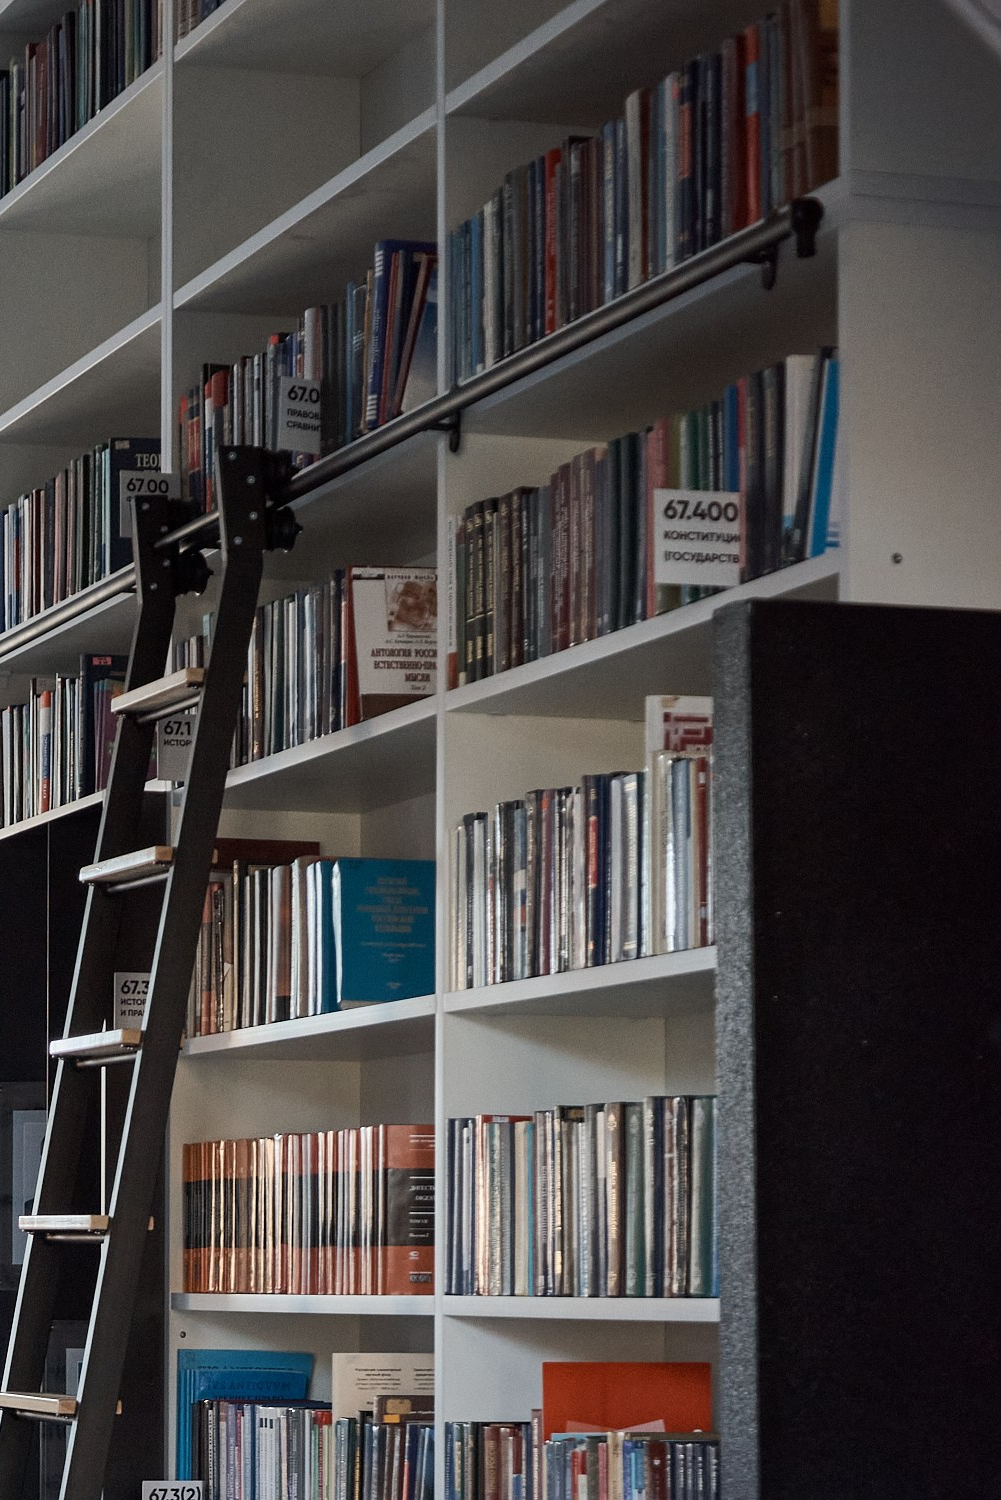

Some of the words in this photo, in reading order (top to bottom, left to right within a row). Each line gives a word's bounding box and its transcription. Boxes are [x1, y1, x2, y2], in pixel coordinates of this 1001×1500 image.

[287, 385, 320, 404] 67.0
[664, 500, 739, 522] 67.400
[164, 720, 191, 736] 67.1
[121, 980, 149, 995] 67.3
